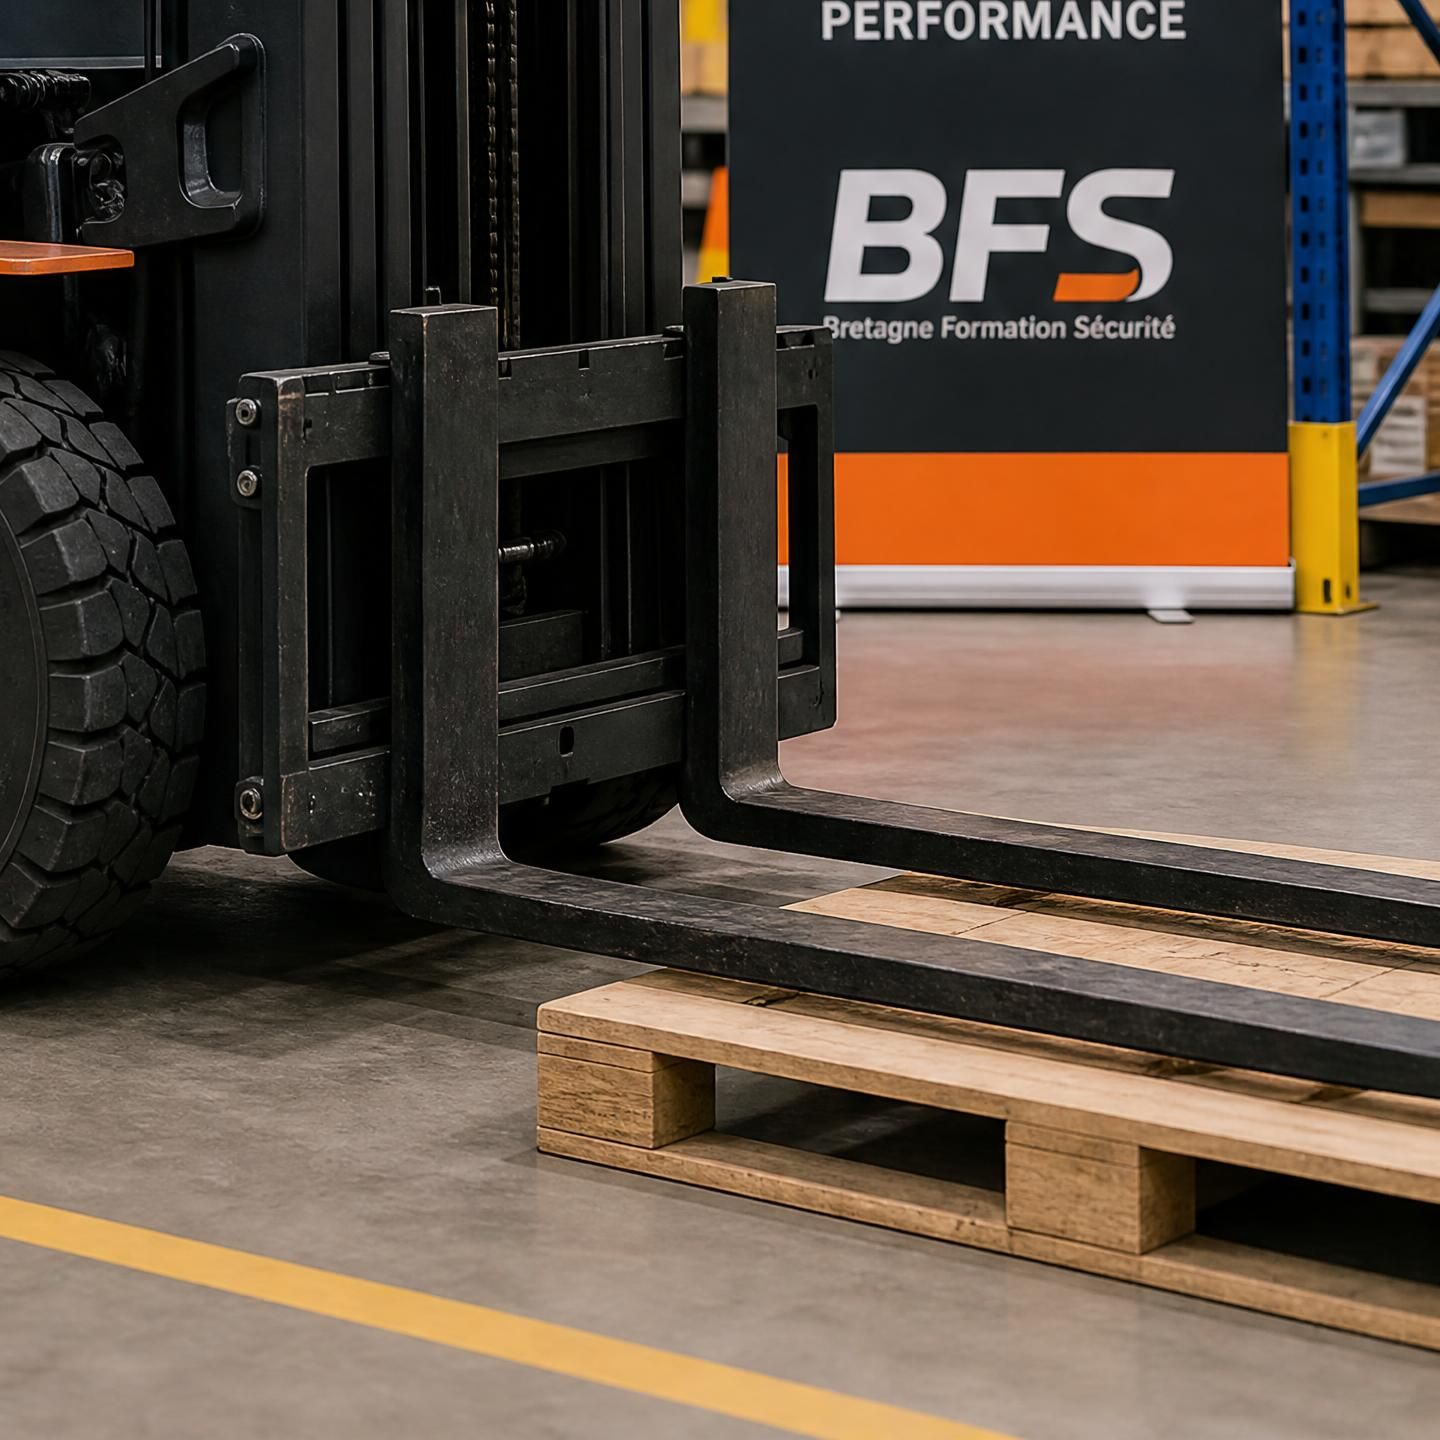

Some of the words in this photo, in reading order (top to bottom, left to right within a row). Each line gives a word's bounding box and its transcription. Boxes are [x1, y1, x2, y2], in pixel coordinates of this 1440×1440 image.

[821, 0, 1187, 41] PERFORMANCE
[823, 168, 1176, 303] BFS
[823, 315, 934, 344] Bretagne
[940, 315, 1067, 340] Formation
[1073, 314, 1177, 341] Sécurité
